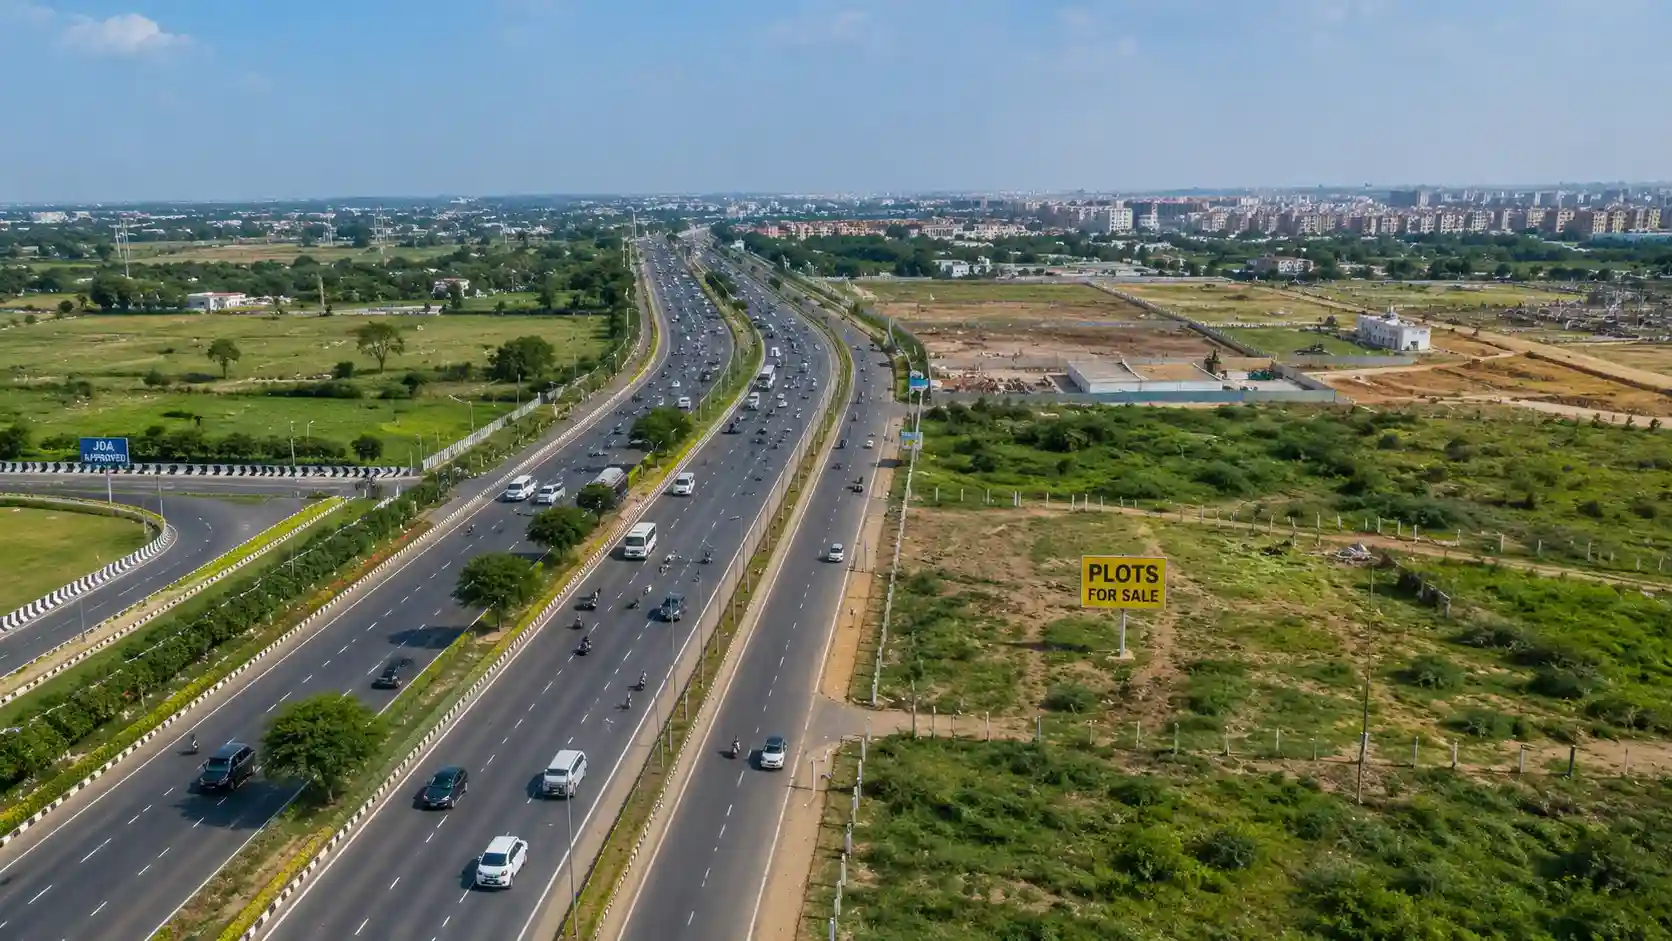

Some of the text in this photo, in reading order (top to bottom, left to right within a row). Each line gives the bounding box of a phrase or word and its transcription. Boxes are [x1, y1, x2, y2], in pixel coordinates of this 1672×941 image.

[93, 440, 114, 451] JDA
[84, 453, 126, 462] APPROVED
[1088, 564, 1159, 583] PLOTS
[1088, 588, 1159, 603] FOR SALE
